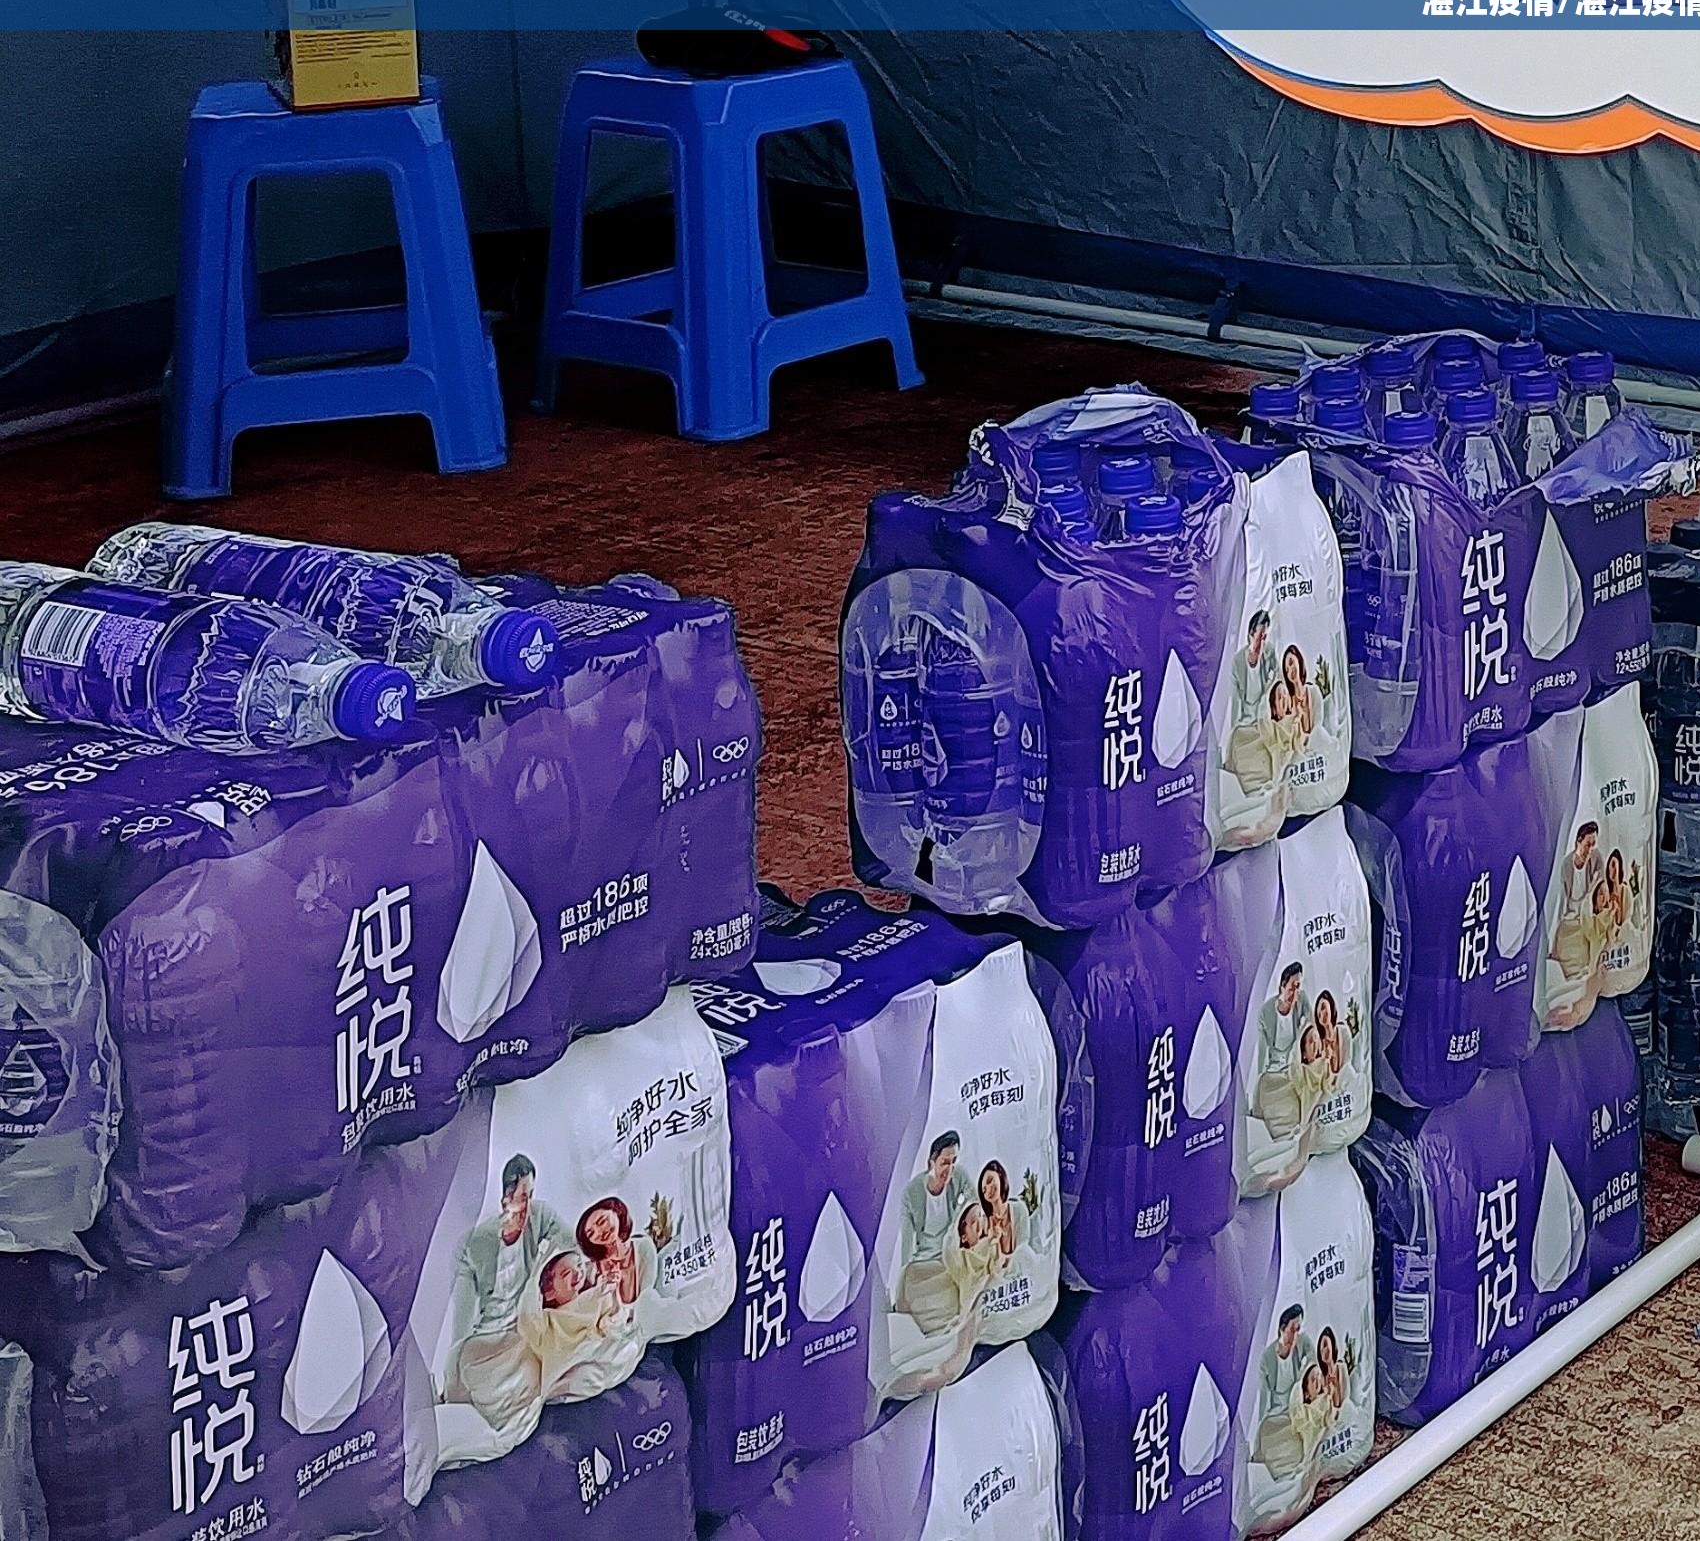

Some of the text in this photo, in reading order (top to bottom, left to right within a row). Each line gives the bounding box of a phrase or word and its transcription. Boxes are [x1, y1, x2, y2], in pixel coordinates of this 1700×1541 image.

[1460, 529, 1508, 701] 纯悦
[1103, 668, 1142, 790] 纯悦
[559, 872, 649, 930] 超过186项
[1457, 871, 1491, 983] 纯悦
[335, 885, 414, 1113] 纯悦
[627, 1095, 714, 1167] 呵护全家
[1144, 1025, 1176, 1150] 纯悦
[743, 1216, 790, 1362] 纯悦
[1476, 1178, 1518, 1350] 纯悦
[167, 1295, 256, 1515] 纯悦
[1132, 1391, 1172, 1515] 纯悦
